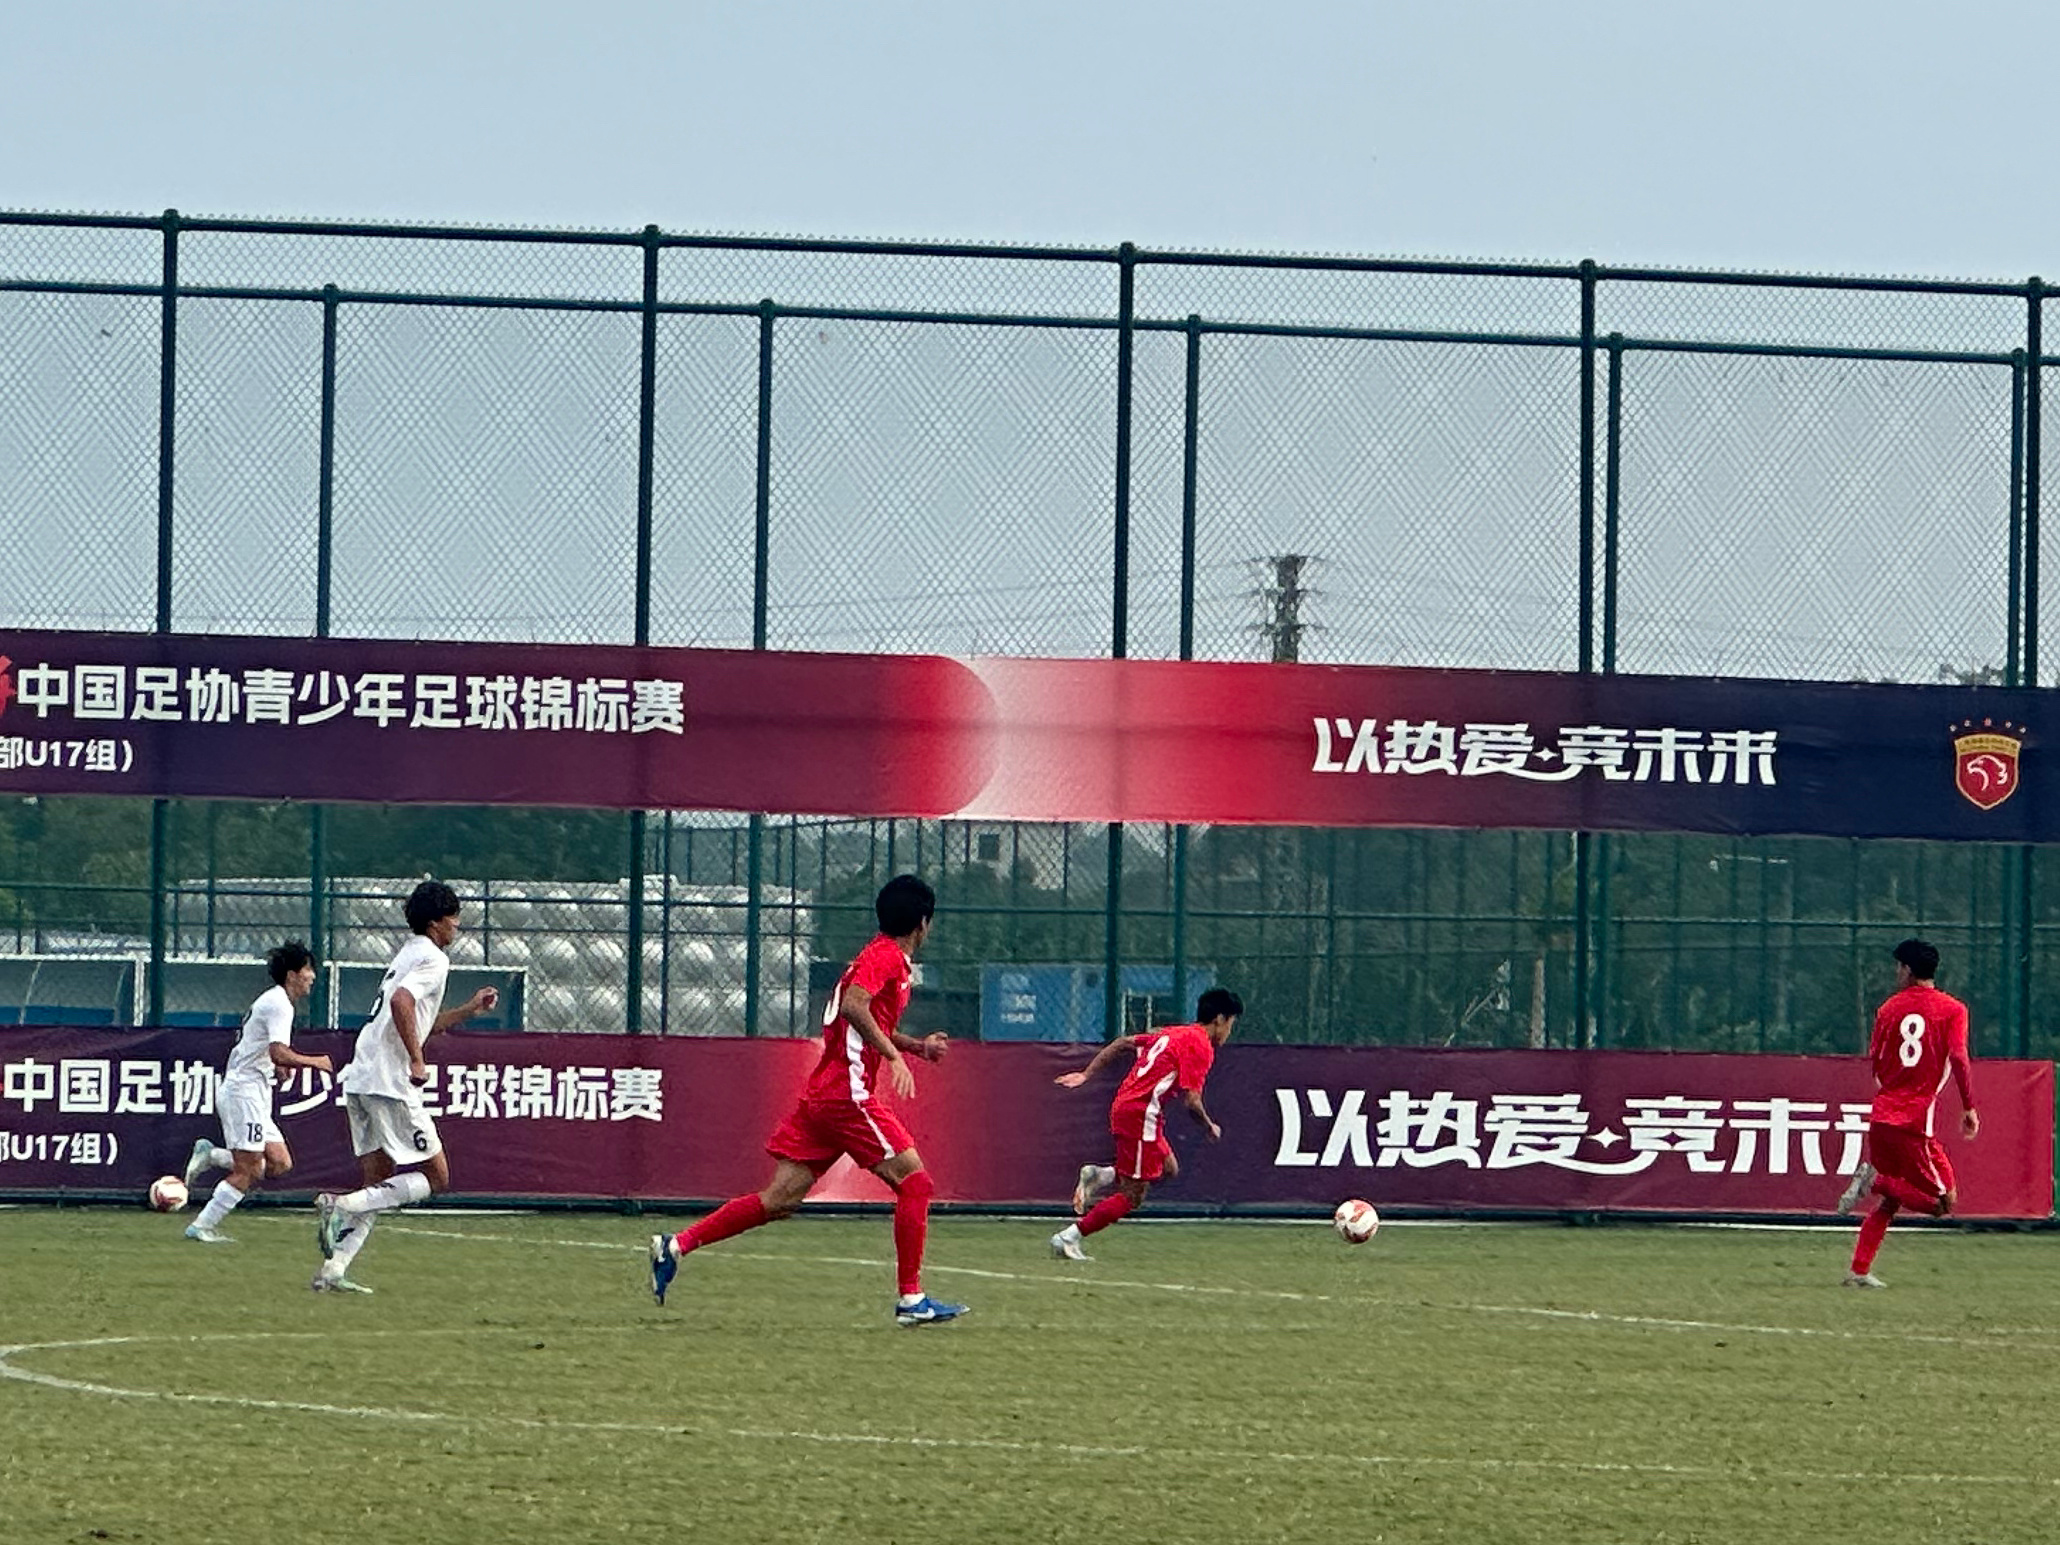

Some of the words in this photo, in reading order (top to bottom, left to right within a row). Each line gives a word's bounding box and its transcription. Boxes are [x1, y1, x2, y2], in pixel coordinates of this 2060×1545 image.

[17, 662, 685, 735] 中国足协青少年足球锦标赛
[1899, 1013, 1925, 1068] 8
[3, 1057, 663, 1122] 中国足协少球锦标赛
[246, 1121, 263, 1143] 18
[412, 1128, 428, 1152] 6
